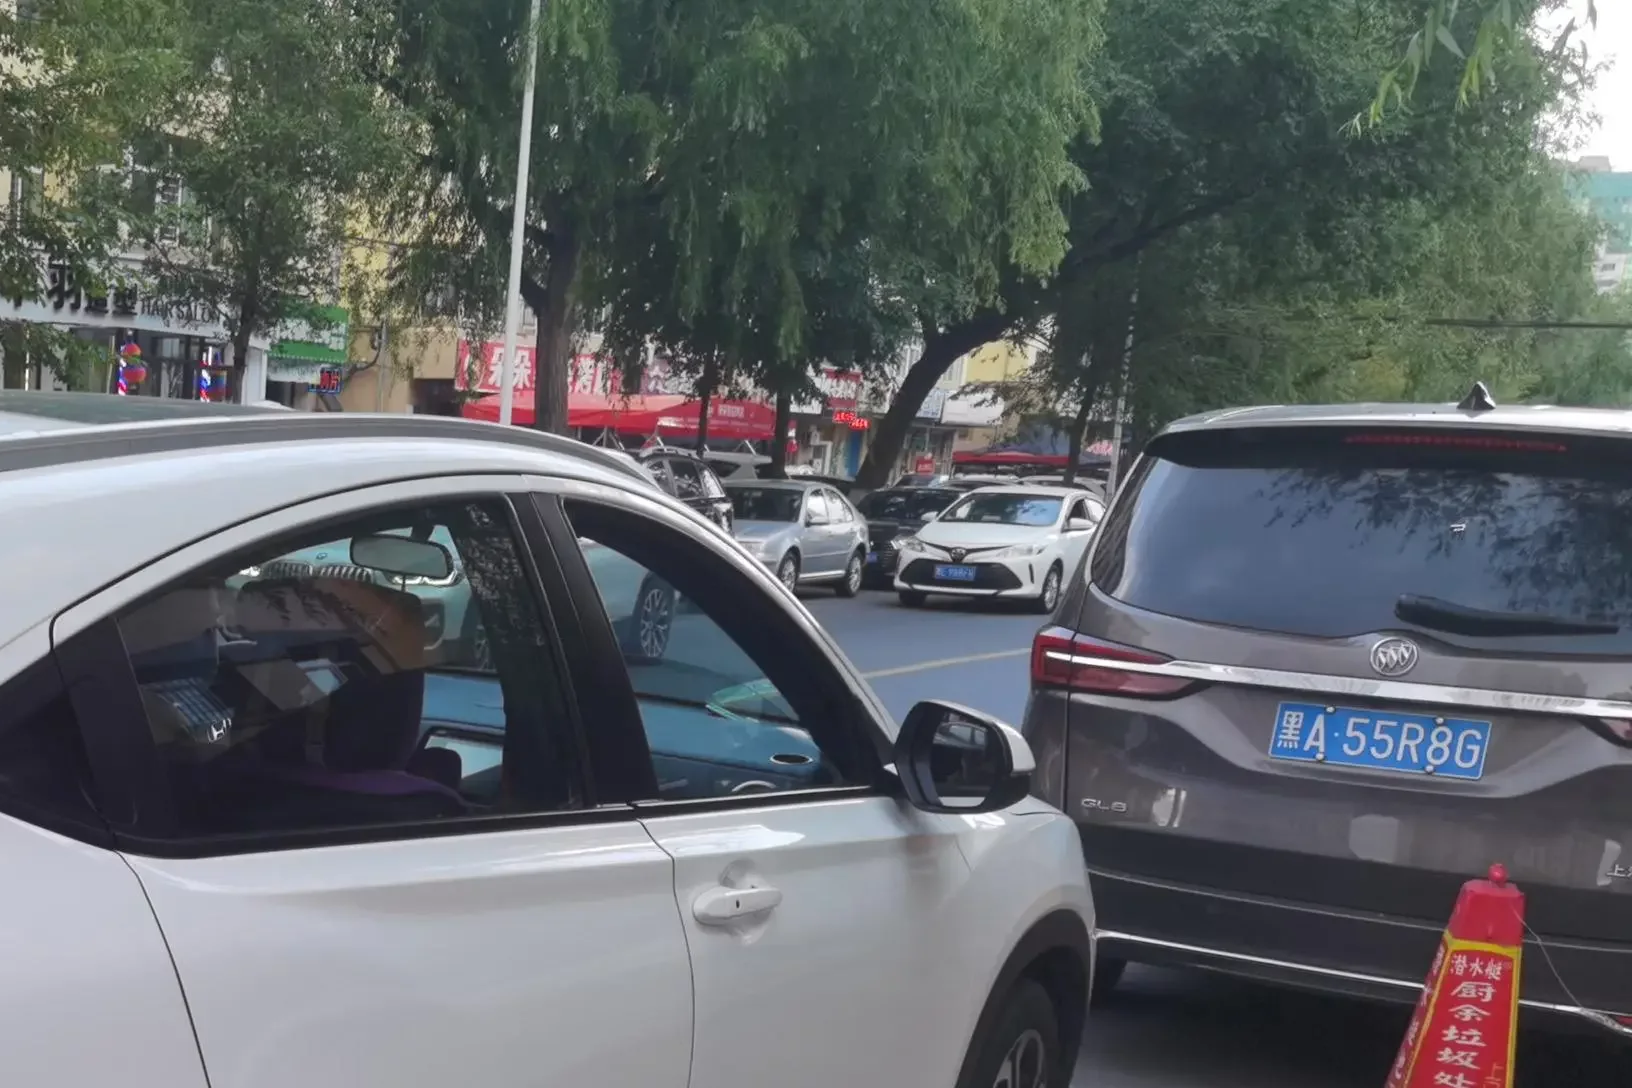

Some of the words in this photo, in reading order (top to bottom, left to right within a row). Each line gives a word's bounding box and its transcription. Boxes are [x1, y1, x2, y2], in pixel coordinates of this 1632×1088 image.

[1277, 710, 1483, 770] 黑A·55R8G
[1450, 954, 1504, 981] 潜水艇
